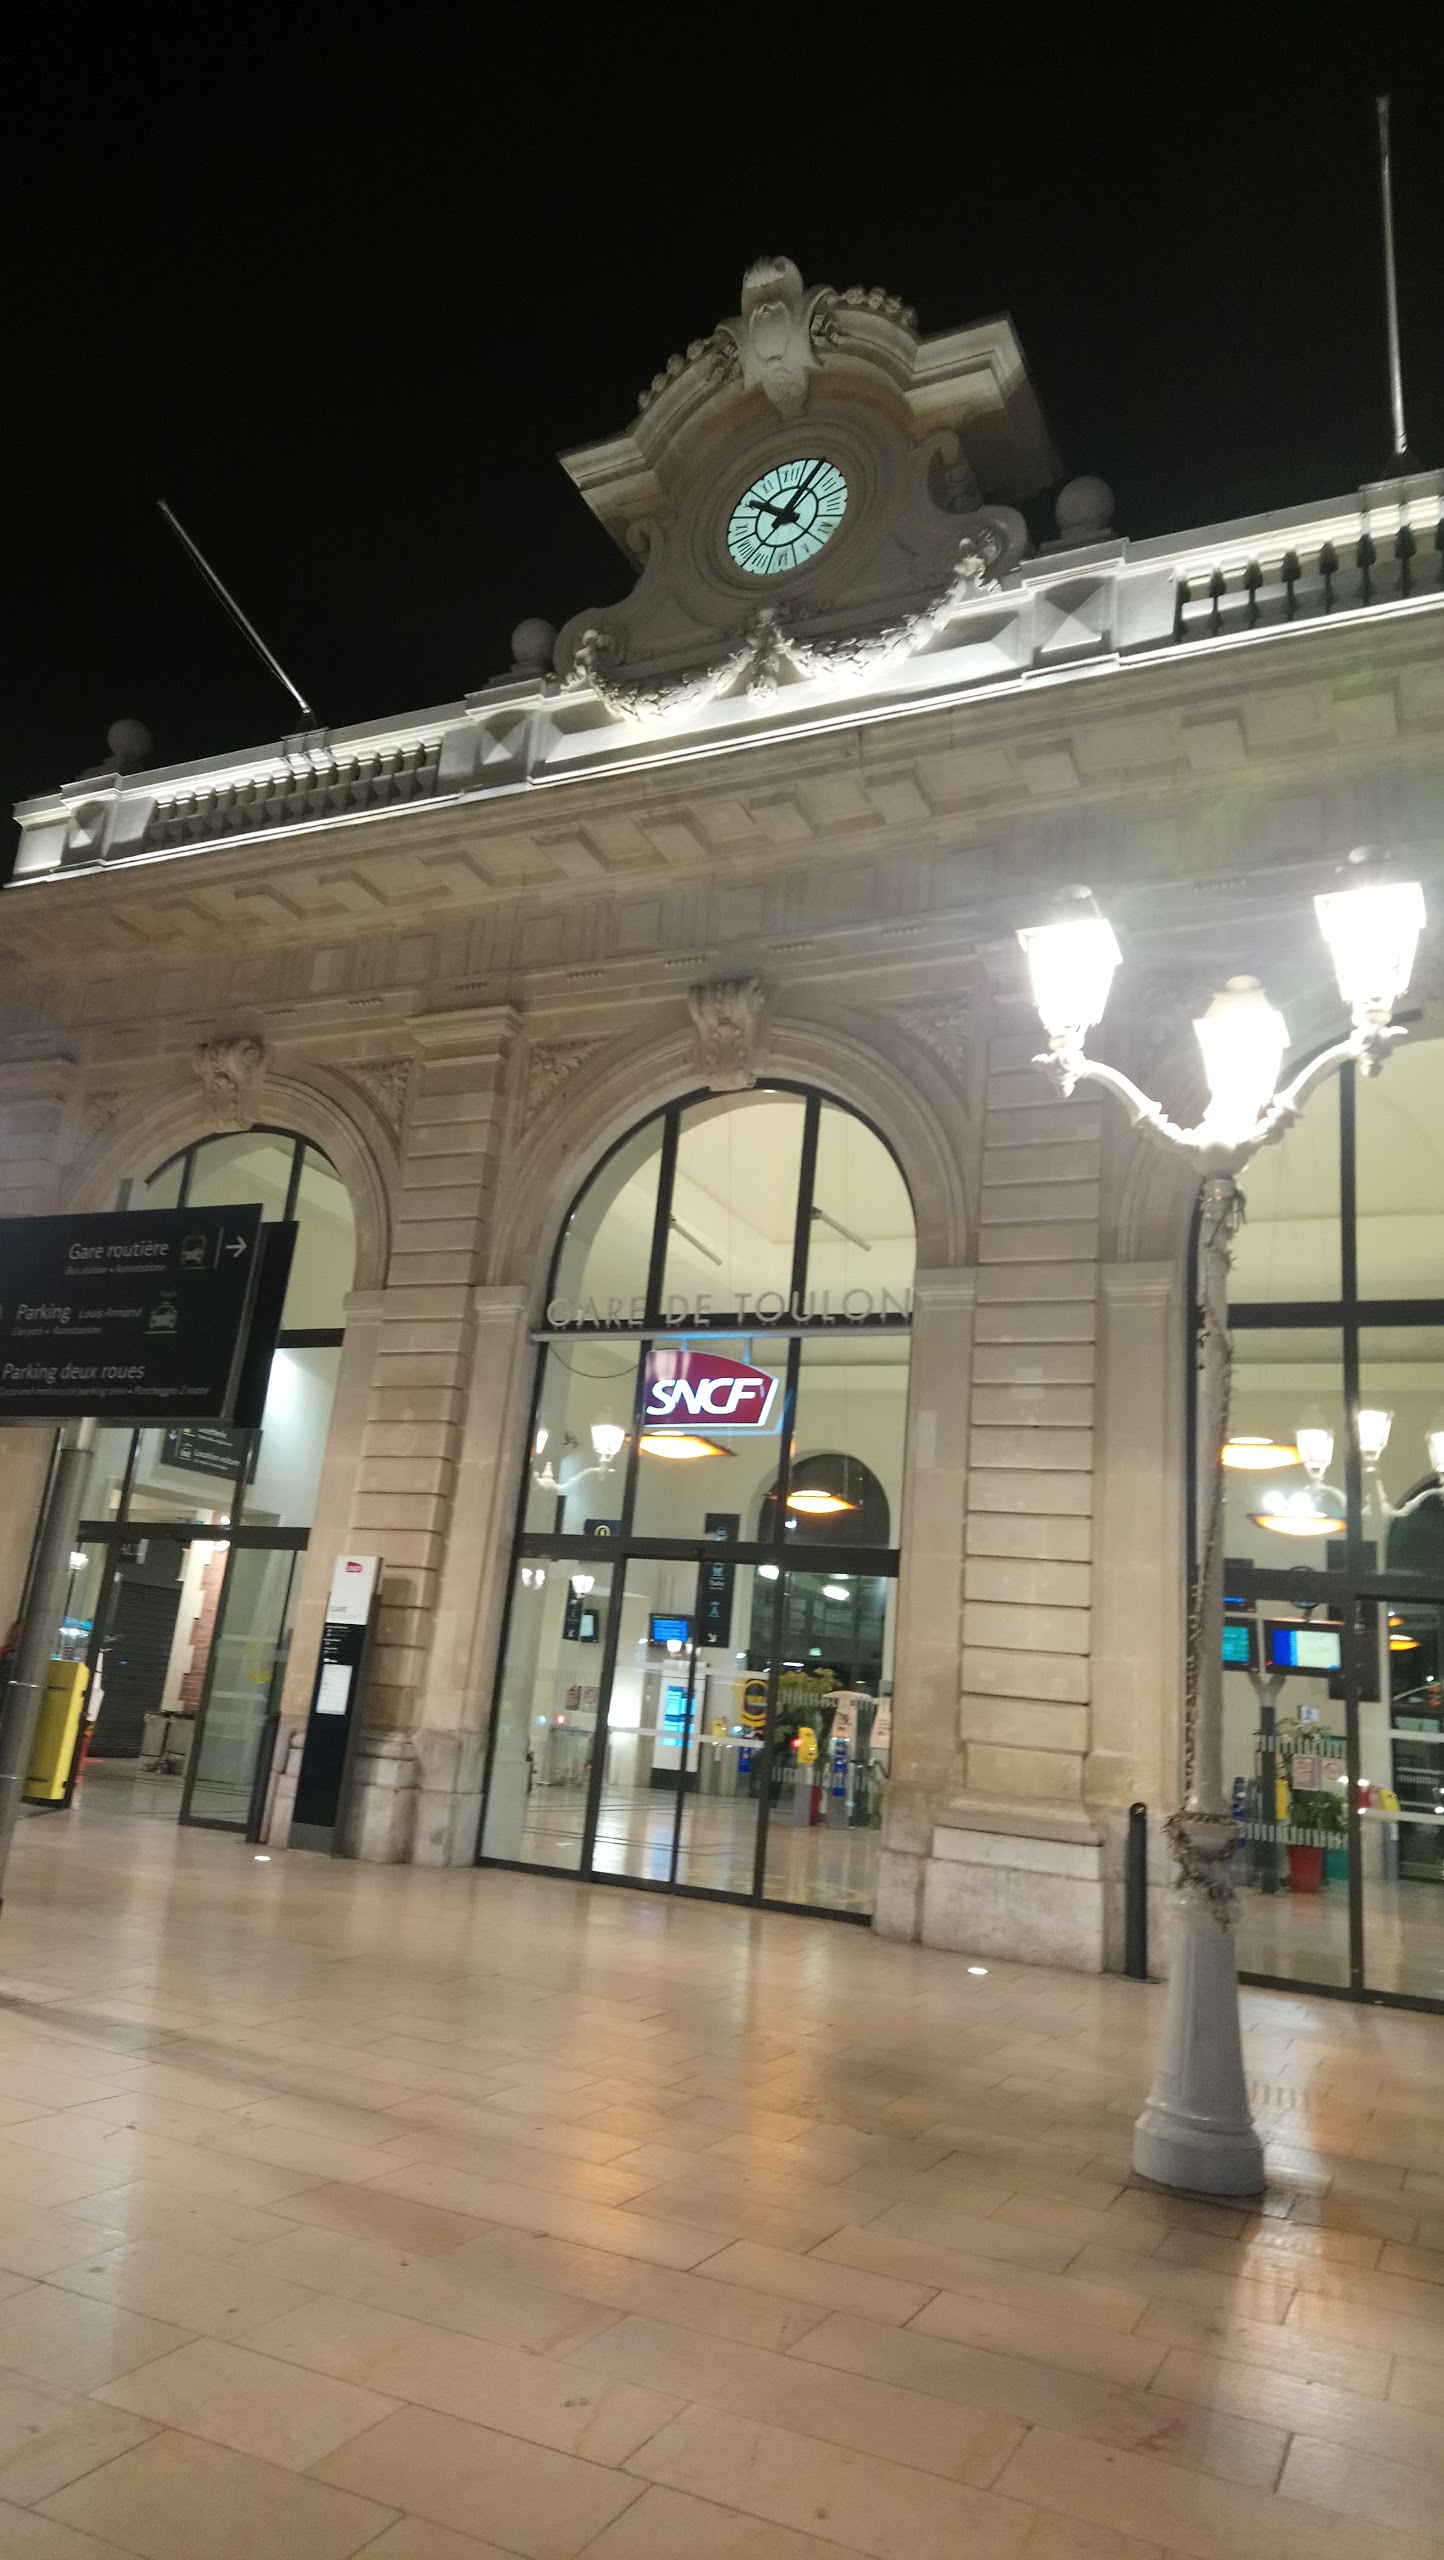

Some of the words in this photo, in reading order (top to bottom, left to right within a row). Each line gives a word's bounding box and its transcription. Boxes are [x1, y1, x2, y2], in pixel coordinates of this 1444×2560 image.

[68, 1243, 105, 1261] Gare
[107, 1240, 170, 1258] routière
[16, 1304, 72, 1324] Parking
[546, 1296, 646, 1328] GARE
[665, 1293, 712, 1326] DE
[734, 1287, 913, 1323] TOULON
[2, 1362, 58, 1384] Parking
[60, 1361, 98, 1380] deux
[101, 1365, 146, 1379] roues
[646, 1377, 764, 1416] SNCF
